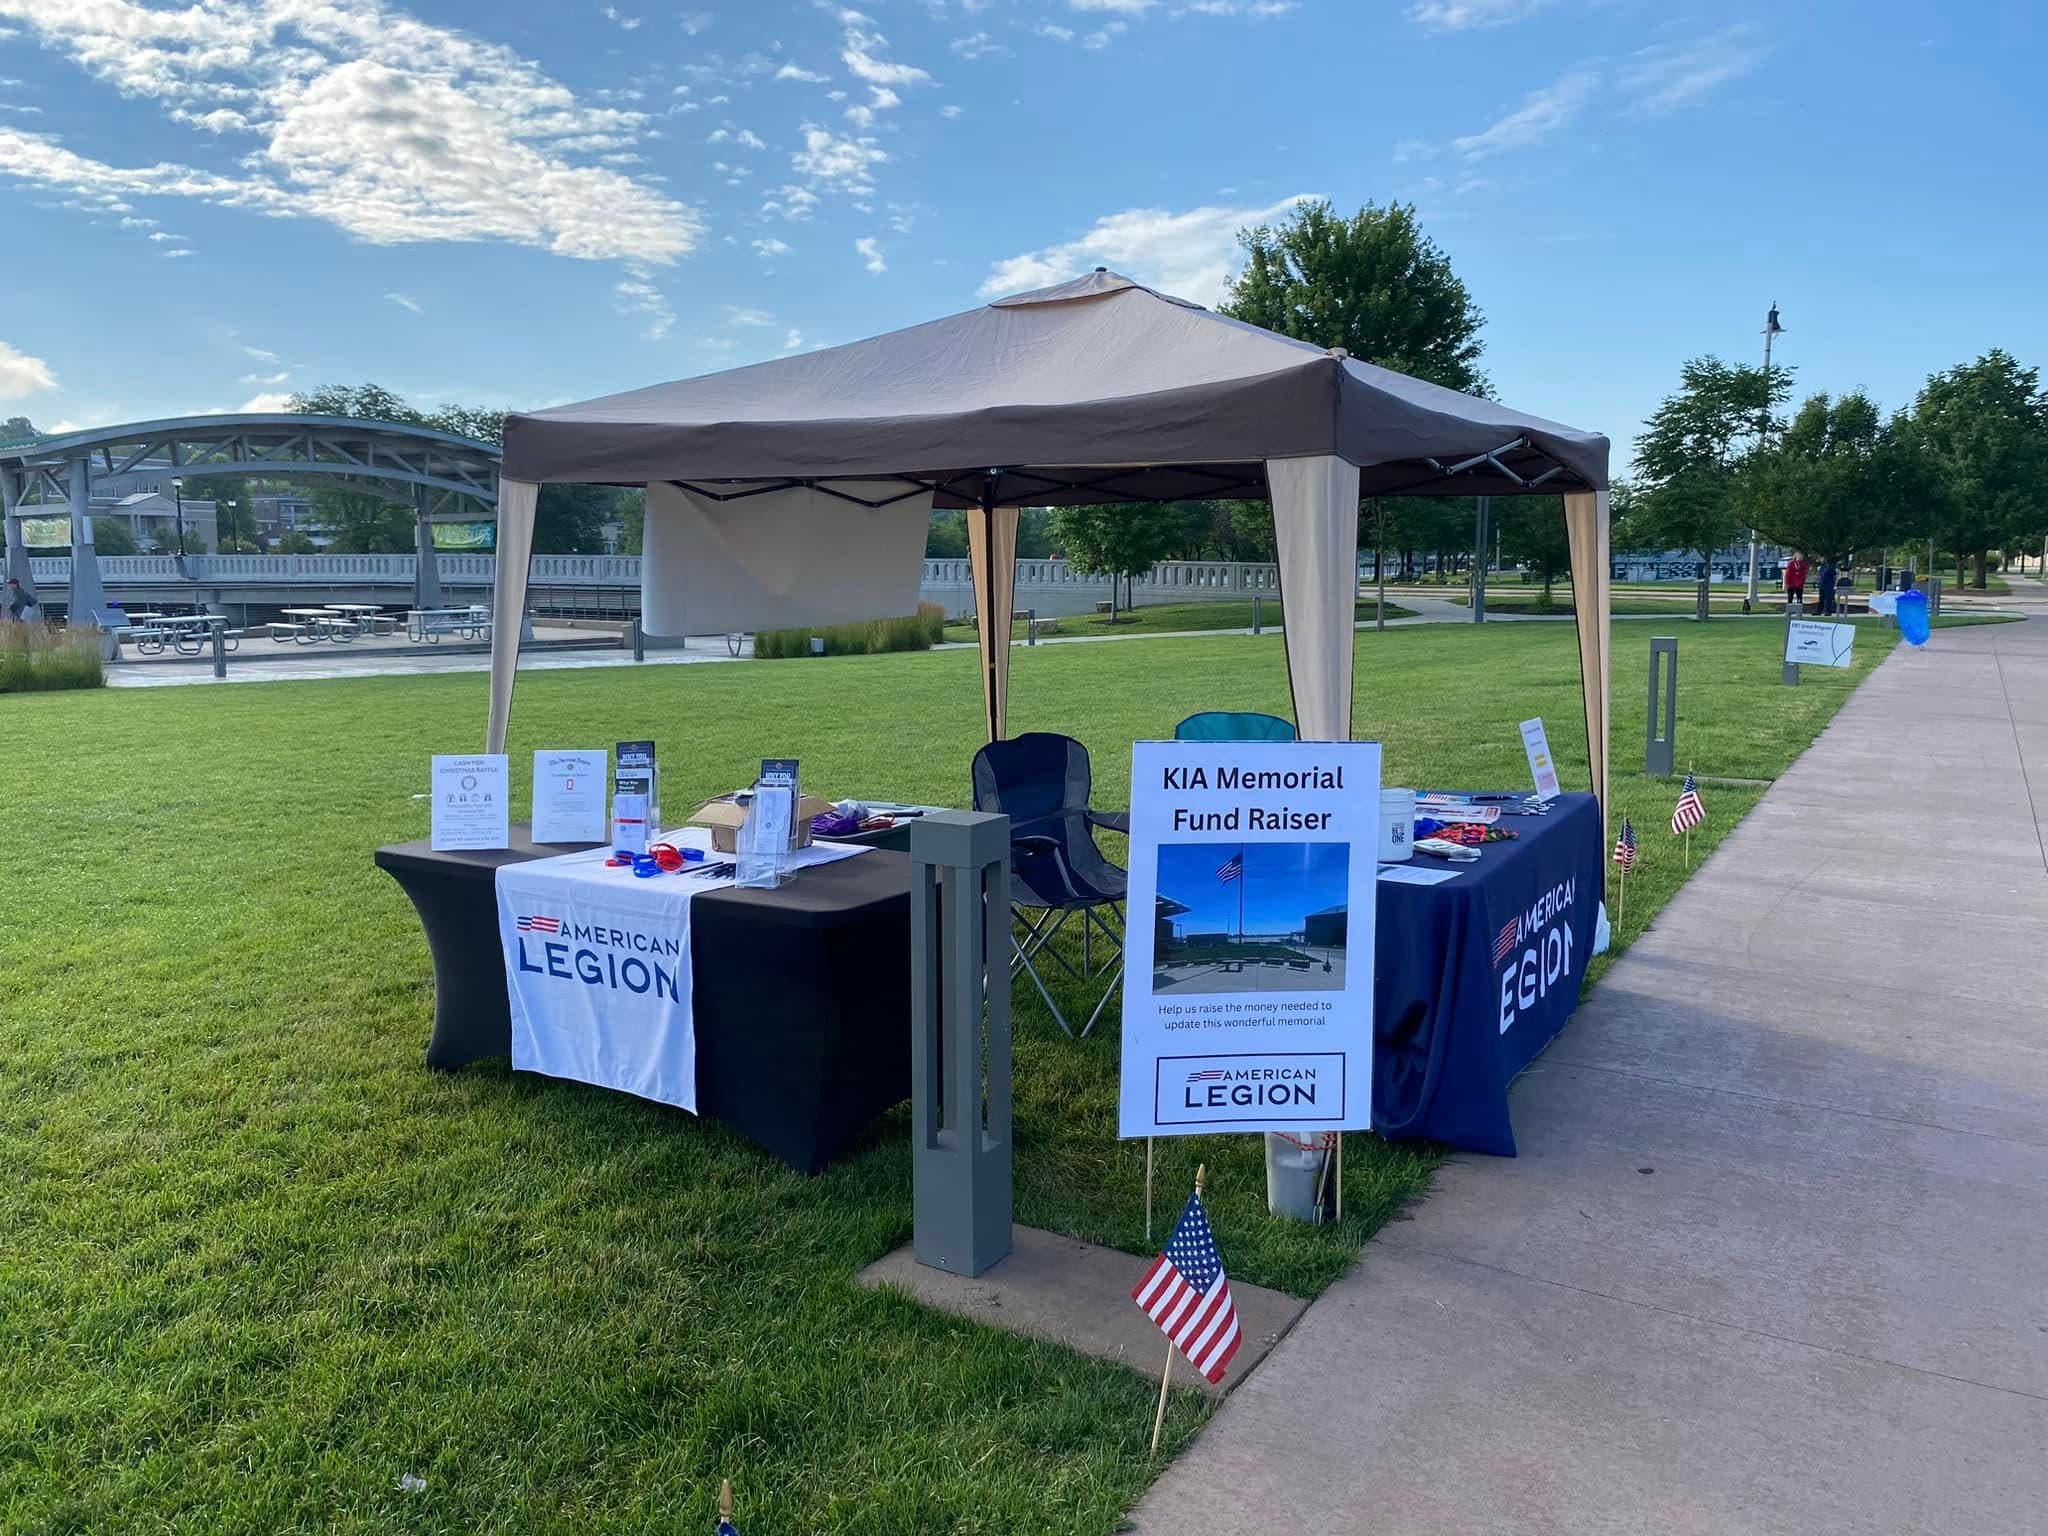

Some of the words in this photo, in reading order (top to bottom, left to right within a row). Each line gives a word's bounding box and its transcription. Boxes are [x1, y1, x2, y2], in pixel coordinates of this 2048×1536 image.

[636, 752, 647, 760] YOU
[1163, 767, 1208, 790] KIA
[1217, 766, 1344, 790] Memorial
[1174, 807, 1239, 831] Fund
[1248, 806, 1332, 830] Raiser
[1392, 833, 1405, 844] ONE
[560, 922, 680, 957] AMERICAN
[518, 937, 680, 1004] LEGION
[1499, 919, 1573, 1036] EGIO
[1158, 1004, 1183, 1016] Help
[1199, 1003, 1223, 1013] raise
[1225, 1002, 1241, 1012] the
[1244, 1004, 1278, 1015] money
[1281, 1001, 1318, 1011] needed
[1321, 1002, 1332, 1010] to
[1164, 1019, 1200, 1031] update
[1203, 1018, 1222, 1028] this
[1224, 1016, 1275, 1028] wonderful
[1277, 1015, 1326, 1026] memorial
[1222, 1068, 1316, 1081] AMERICAN
[1185, 1084, 1316, 1108] LEGION
